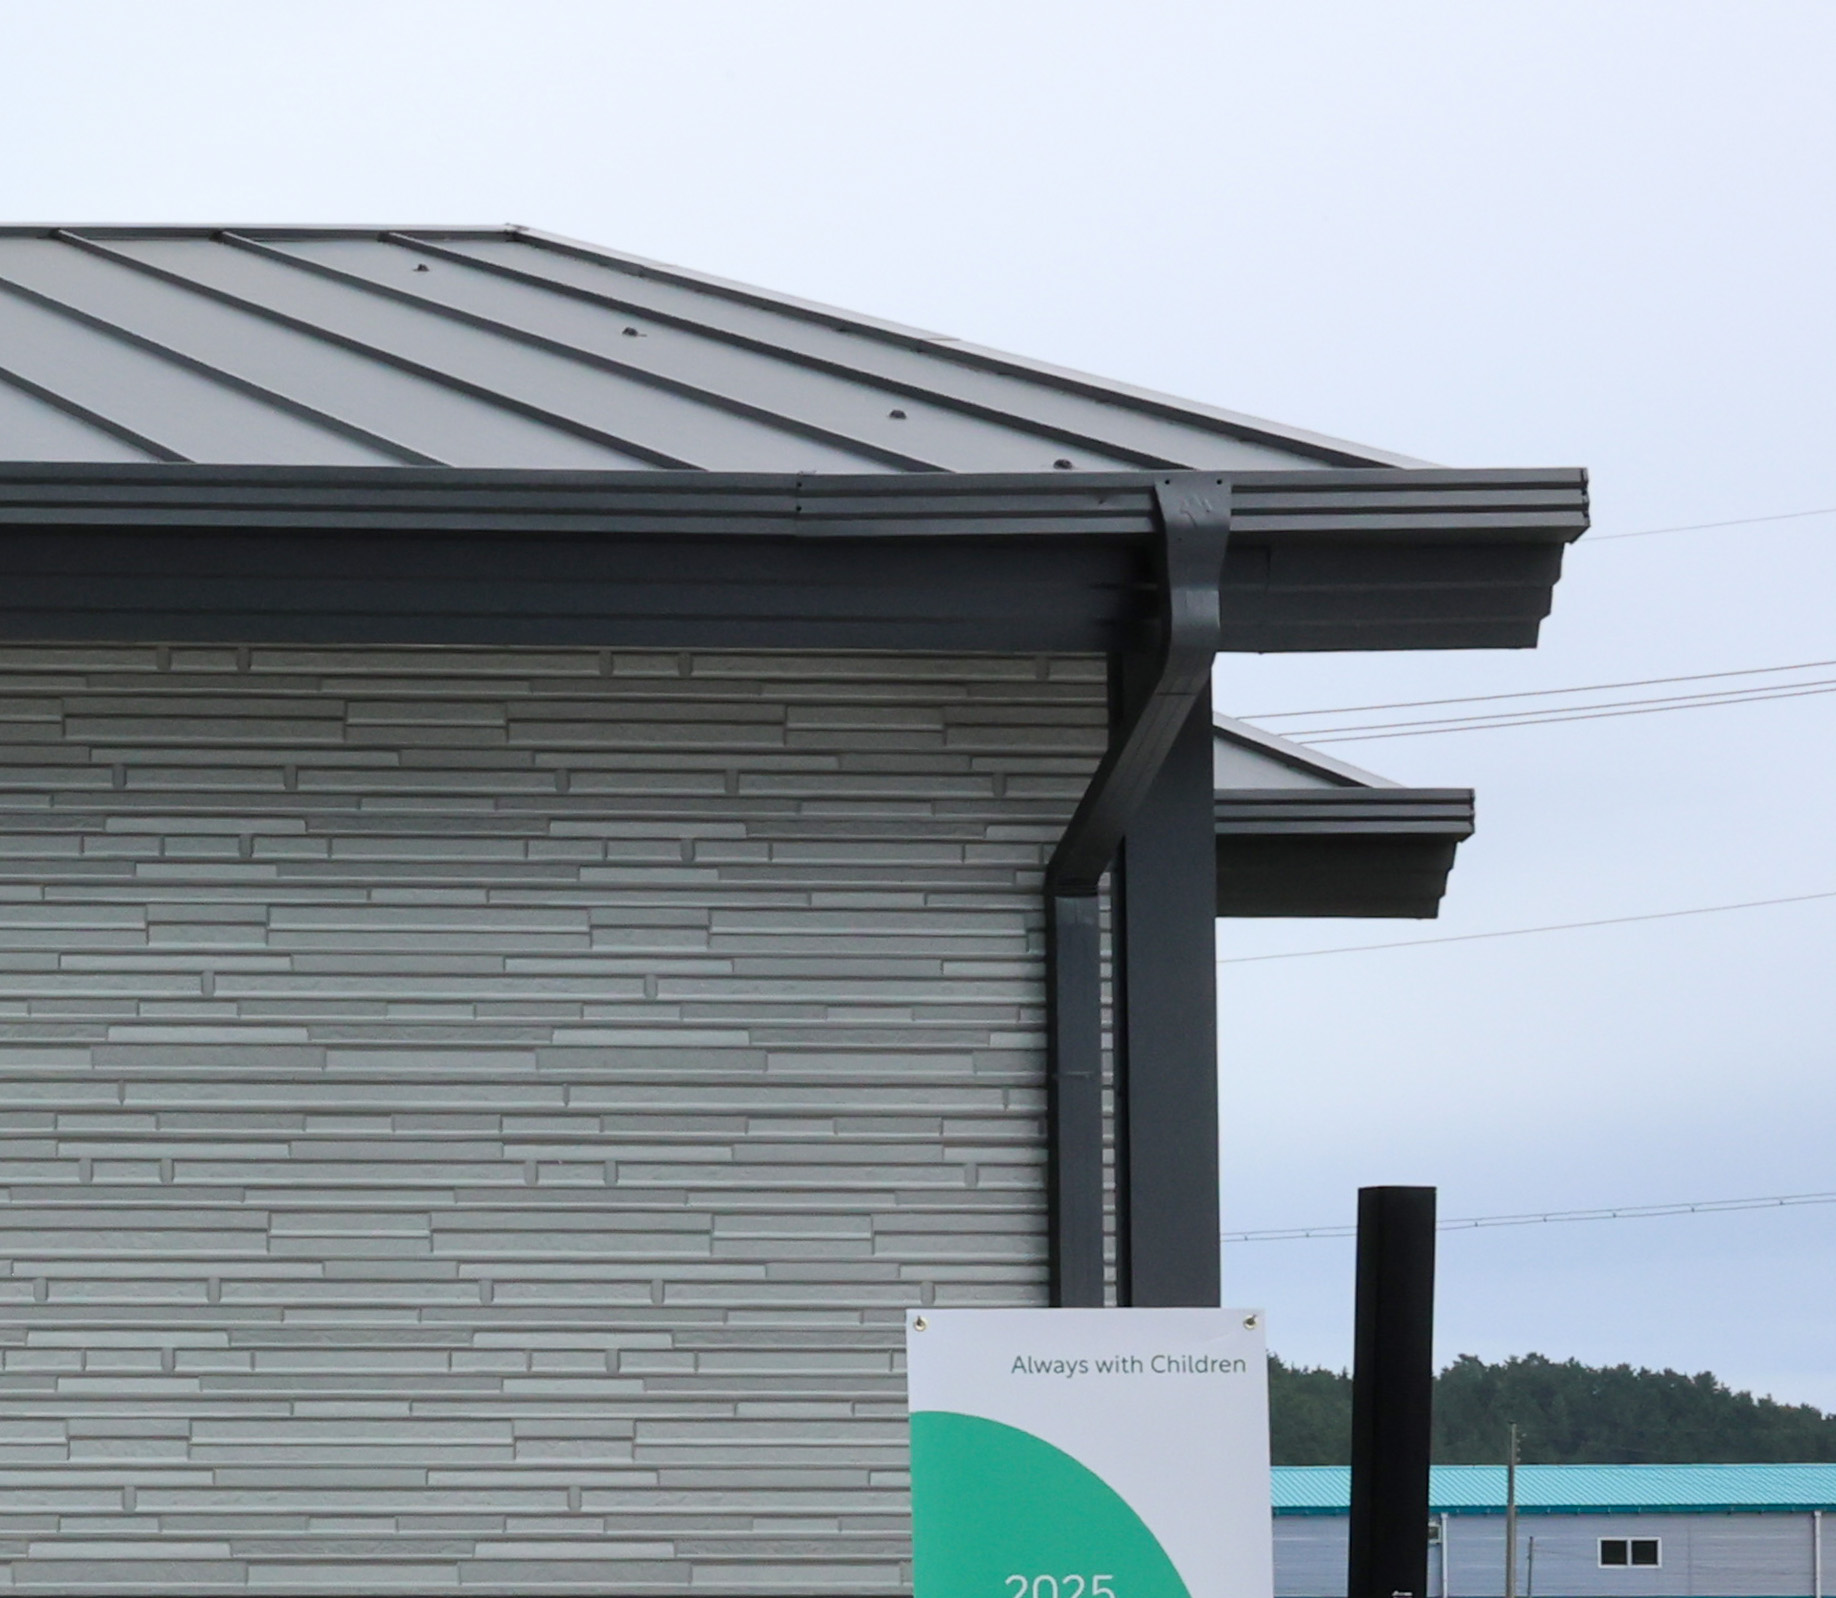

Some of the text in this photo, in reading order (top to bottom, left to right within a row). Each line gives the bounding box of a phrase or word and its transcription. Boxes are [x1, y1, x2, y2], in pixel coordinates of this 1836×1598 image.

[1011, 1354, 1246, 1379] Always with Children
